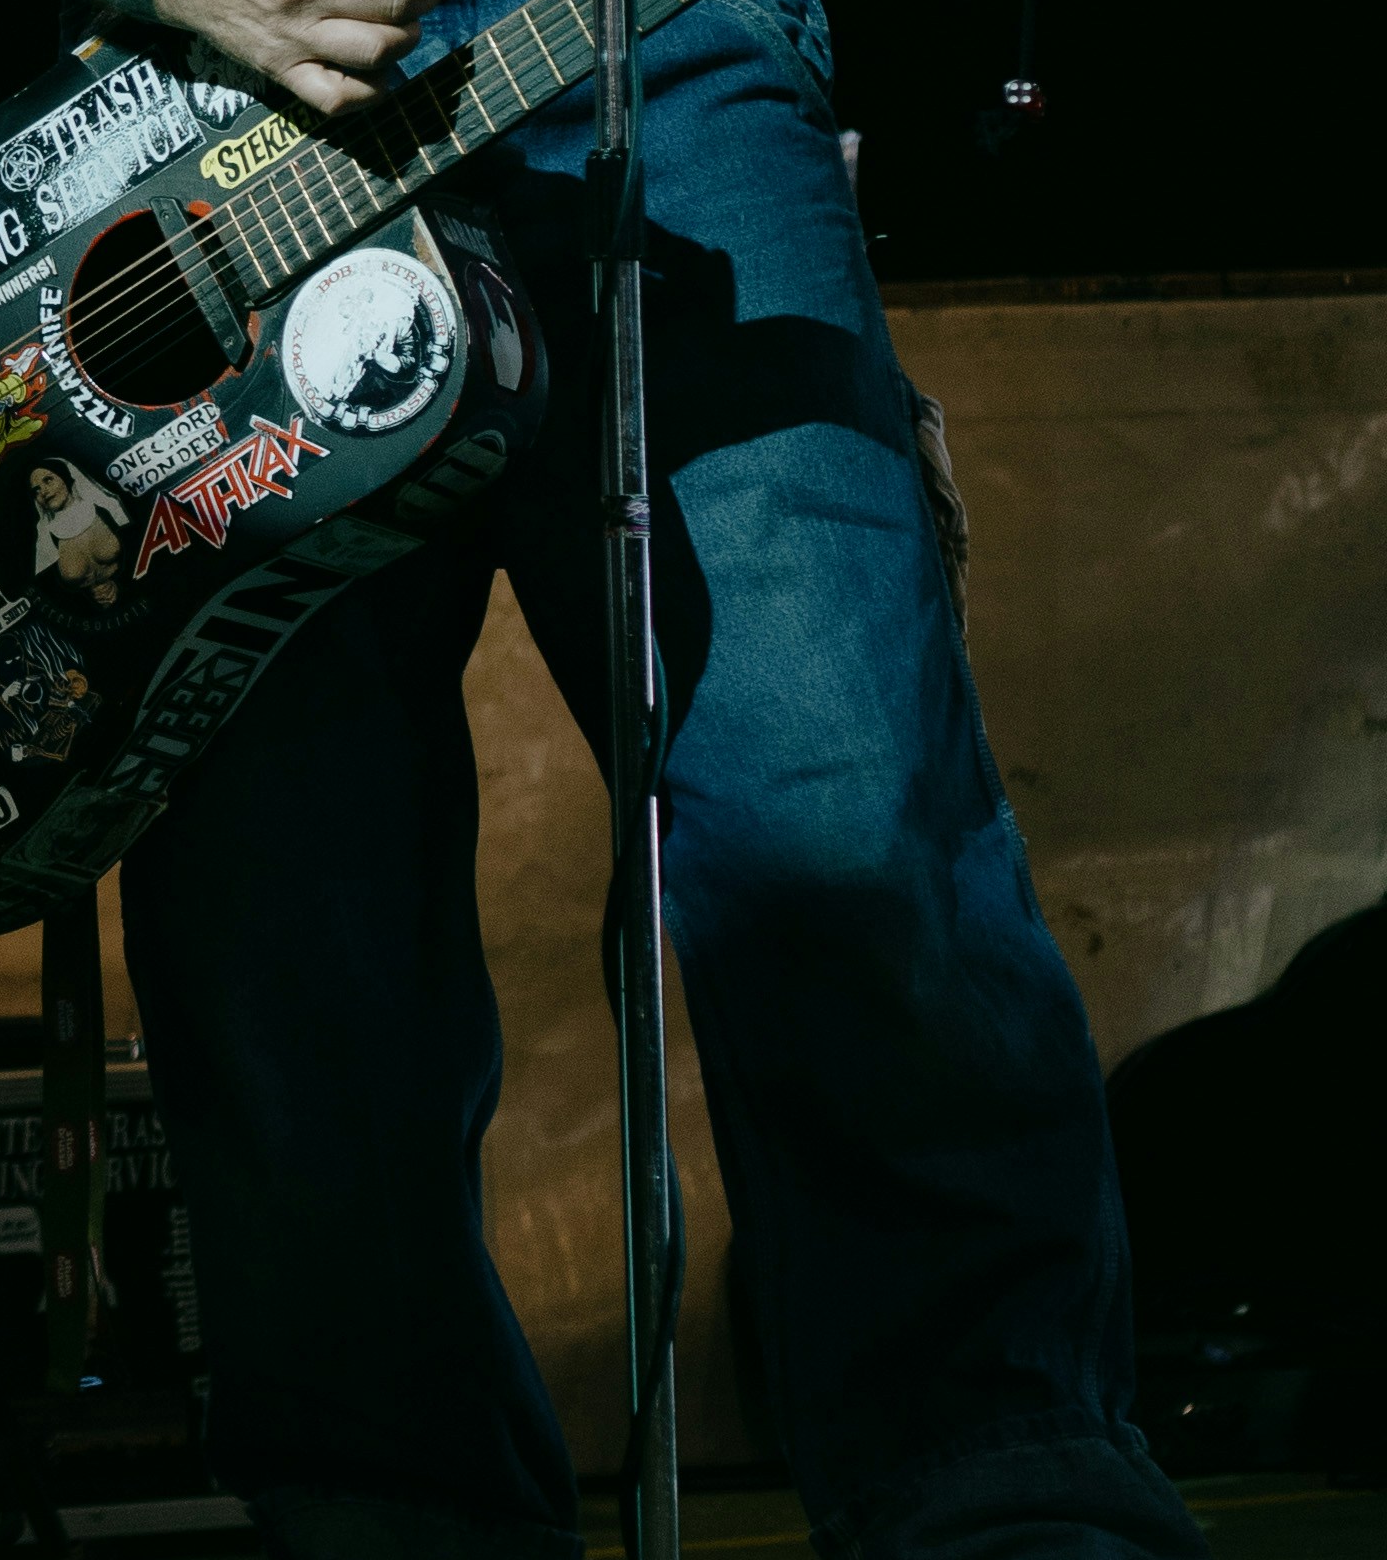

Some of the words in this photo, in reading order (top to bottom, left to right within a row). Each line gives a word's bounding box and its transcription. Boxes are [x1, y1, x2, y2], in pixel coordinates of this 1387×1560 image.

[41, 58, 167, 165] TRASH
[292, 326, 325, 410] COWBOY
[315, 264, 353, 294] BOB
[371, 383, 433, 426] TRASH
[108, 450, 150, 481] ONE
[126, 427, 223, 494] WONDER
[133, 413, 330, 579] ANTHRAX
[105, 1148, 180, 1193] RVIC
